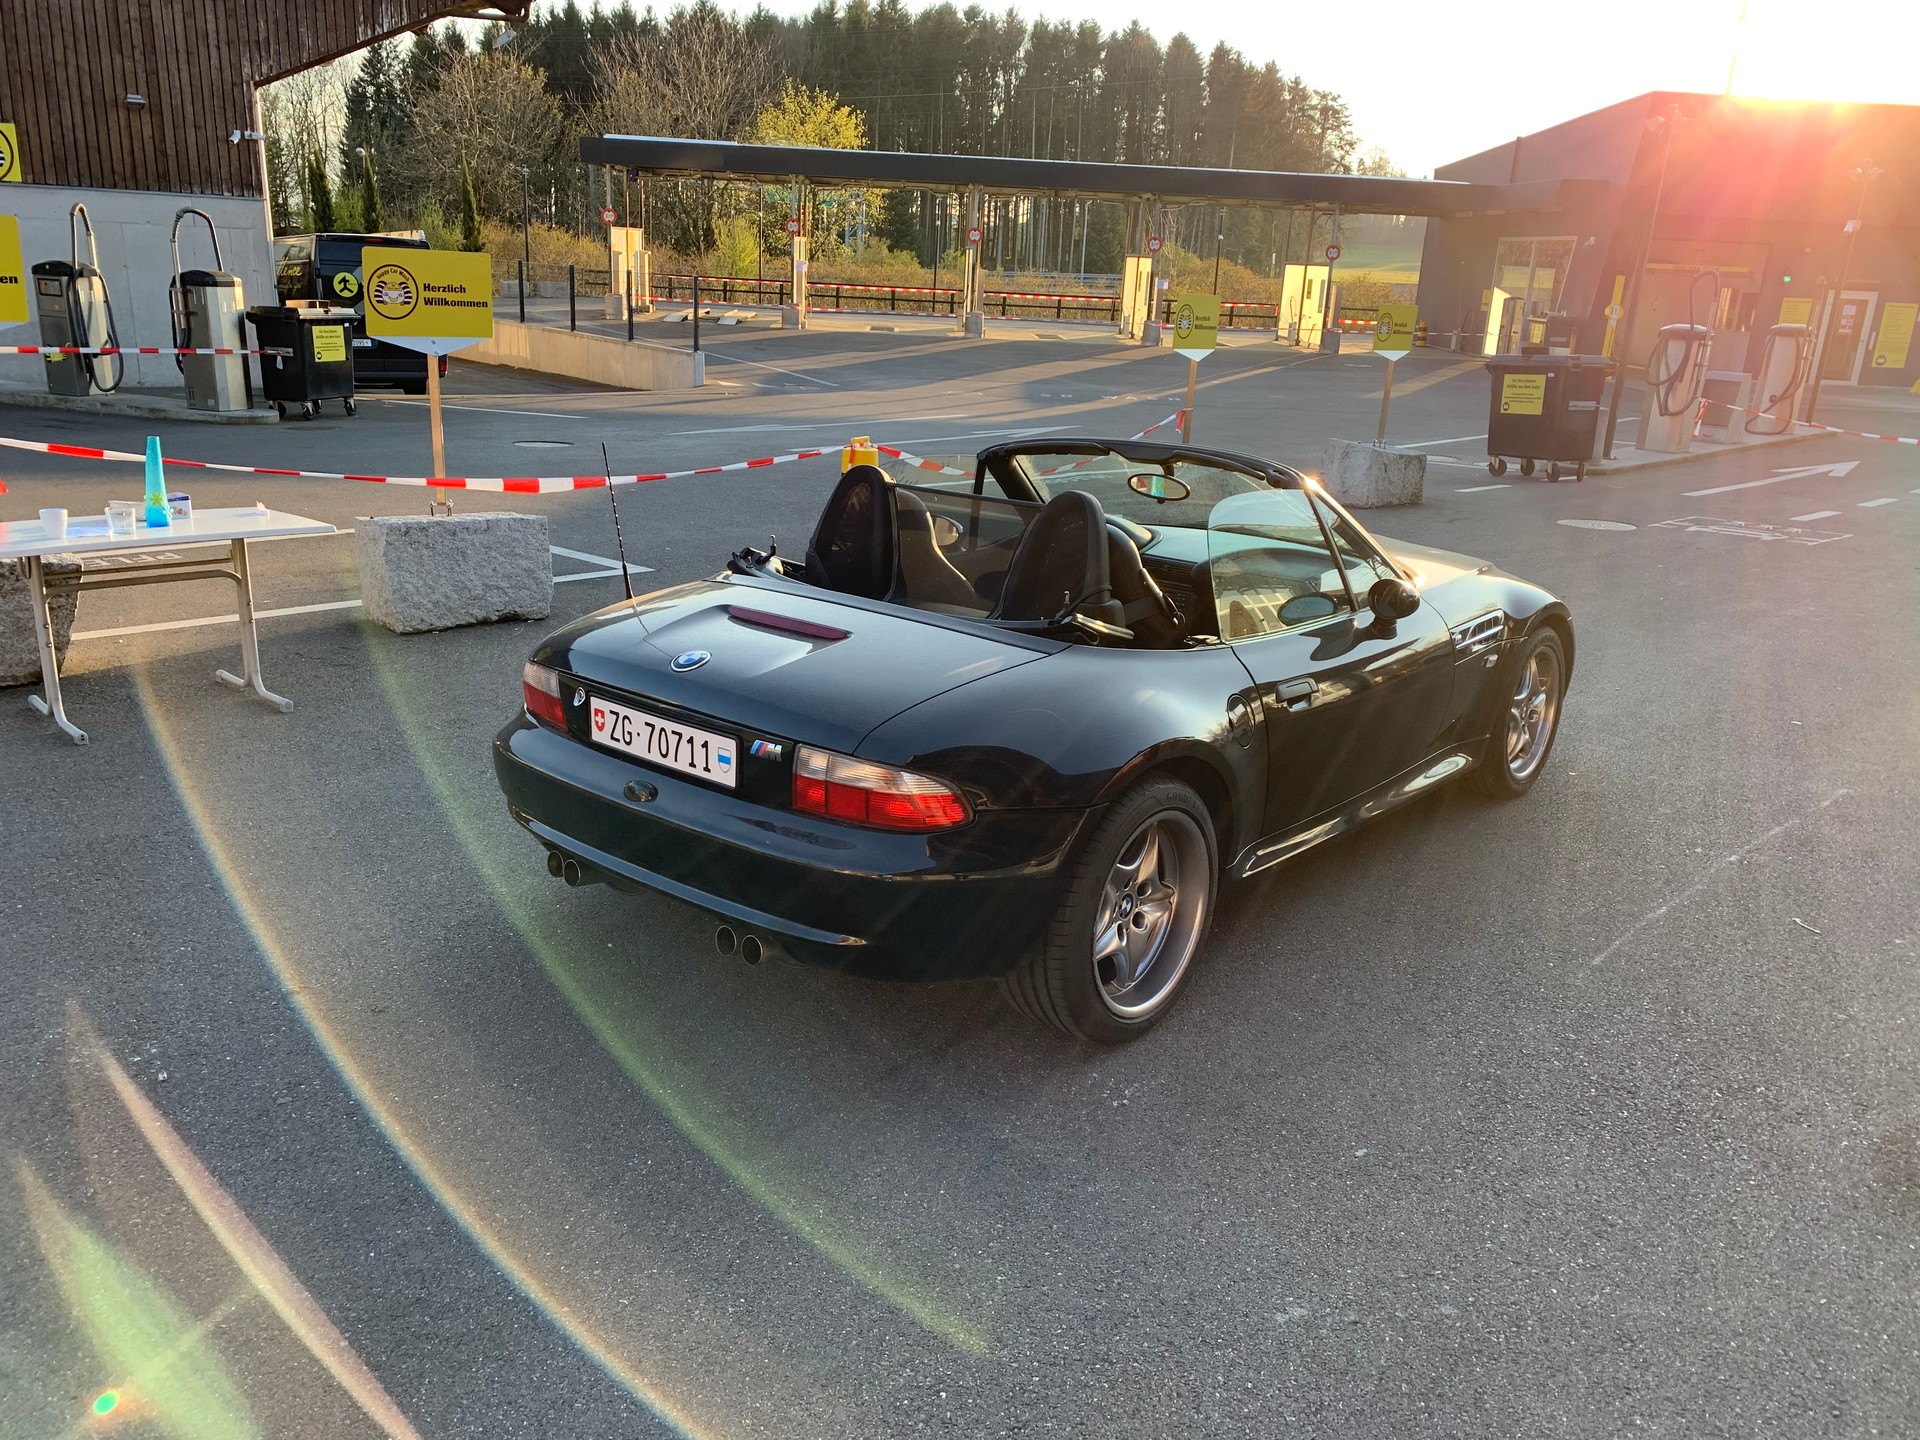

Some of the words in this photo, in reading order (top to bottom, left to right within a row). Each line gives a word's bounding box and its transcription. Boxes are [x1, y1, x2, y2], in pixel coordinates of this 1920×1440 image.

[376, 270, 390, 280] Happy
[399, 270, 410, 282] Wash
[423, 283, 466, 294] Herzlich
[424, 297, 488, 308] Willkommen
[84, 552, 183, 567] PFLE
